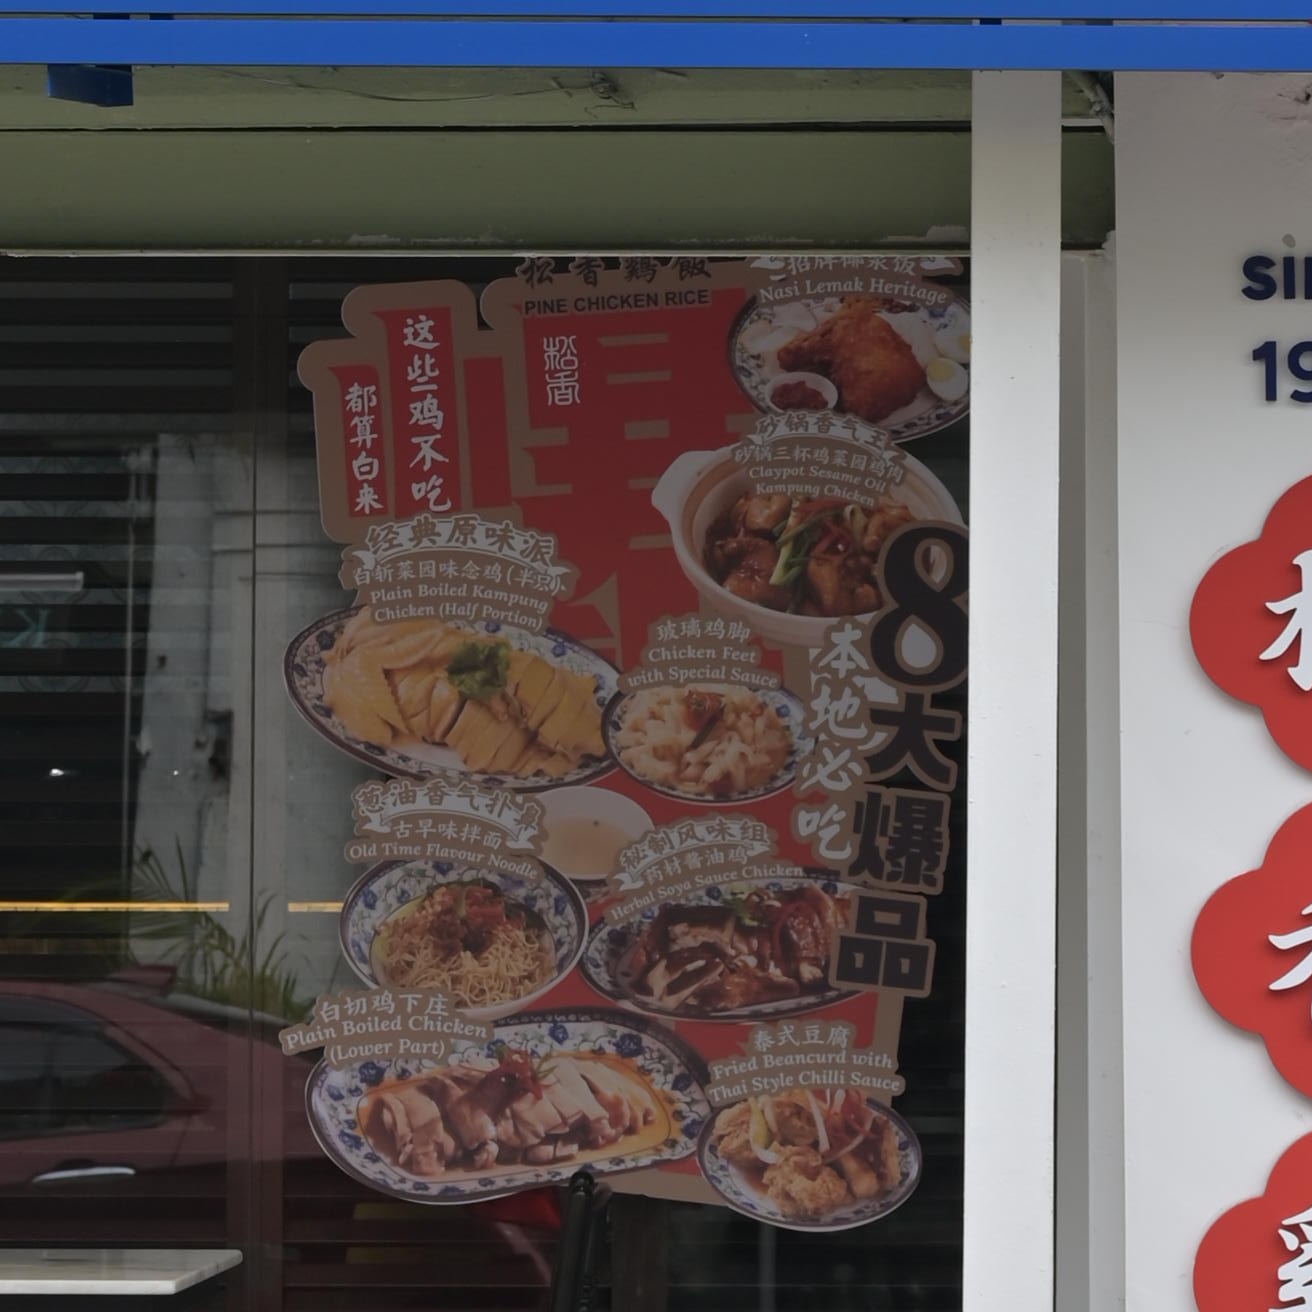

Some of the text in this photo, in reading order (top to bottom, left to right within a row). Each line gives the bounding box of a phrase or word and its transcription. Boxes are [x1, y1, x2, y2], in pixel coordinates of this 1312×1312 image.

[524, 289, 709, 315] PINE CHICKEN RICE
[759, 276, 948, 305] Nasi Lemak Heritage
[403, 314, 451, 513] 这些鸡不吃
[344, 382, 384, 514] 都算白来
[749, 464, 887, 493] Claypot Sesame Oil
[756, 482, 875, 507] Kampung Chicken
[370, 584, 549, 614] Plain Boiled Kampung
[374, 602, 543, 630] Chicken (Half Portion)
[656, 617, 751, 643] 玻璃鸡脚
[648, 644, 757, 663] Chicken Feet
[627, 665, 778, 688] with Special Sauce
[798, 623, 870, 860] 本地必吃
[393, 818, 502, 850] 古早味拌面
[350, 842, 538, 879] Old Time Flavour Noodle
[610, 864, 804, 920] Herbal Soya Sauce Chicken
[319, 989, 449, 1024] 白切鸡下庄
[286, 1015, 488, 1050] Plain Boiled Chicken
[753, 1024, 850, 1053] 泰式豆腐
[330, 1038, 446, 1065] (Lower Part)
[712, 1050, 893, 1080] Fried Beancurd with
[708, 1070, 901, 1103] Thai Style Chilli Sauce
